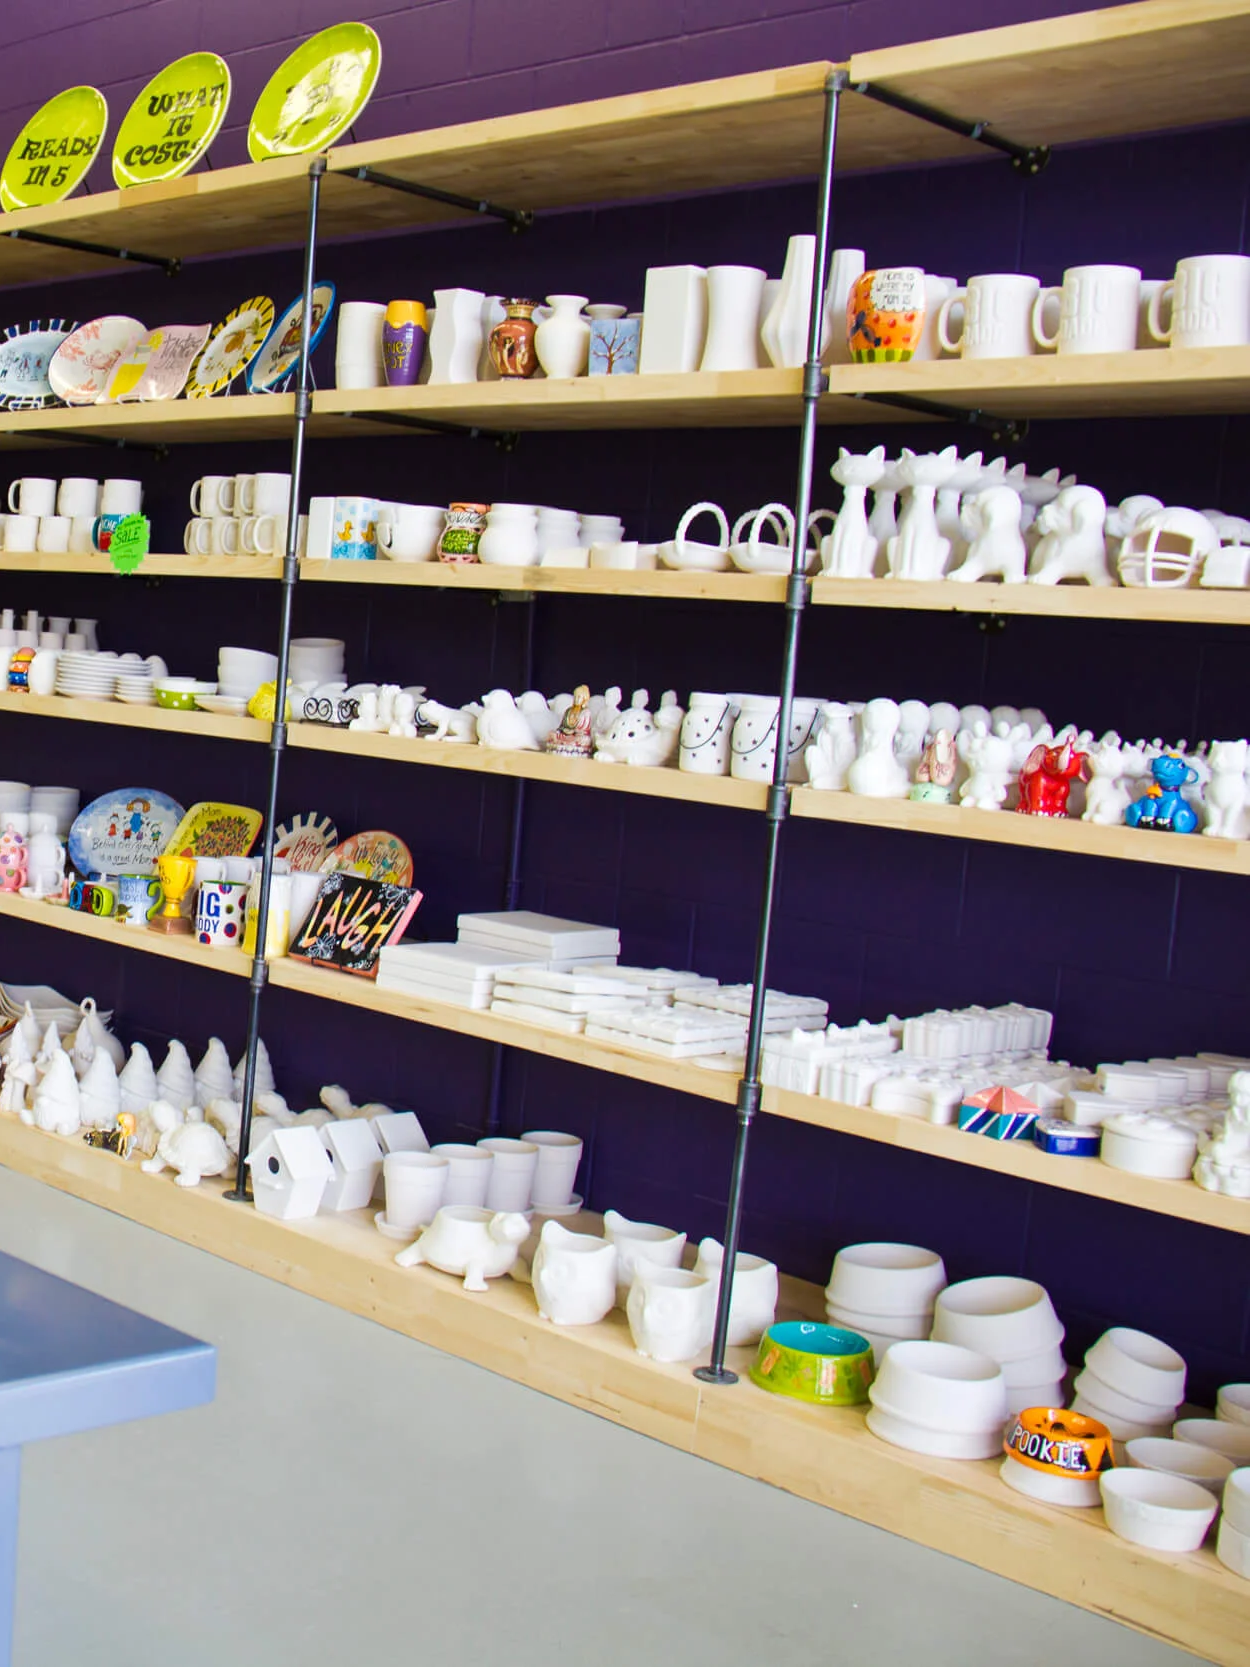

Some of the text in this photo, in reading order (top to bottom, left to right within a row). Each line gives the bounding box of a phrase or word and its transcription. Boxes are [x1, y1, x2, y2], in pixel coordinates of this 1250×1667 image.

[148, 83, 225, 116] WHAT
[163, 114, 194, 138] IT
[17, 135, 101, 160] READY
[22, 164, 71, 187] IN 5
[199, 890, 220, 918] IG
[301, 885, 406, 954] LAUGH
